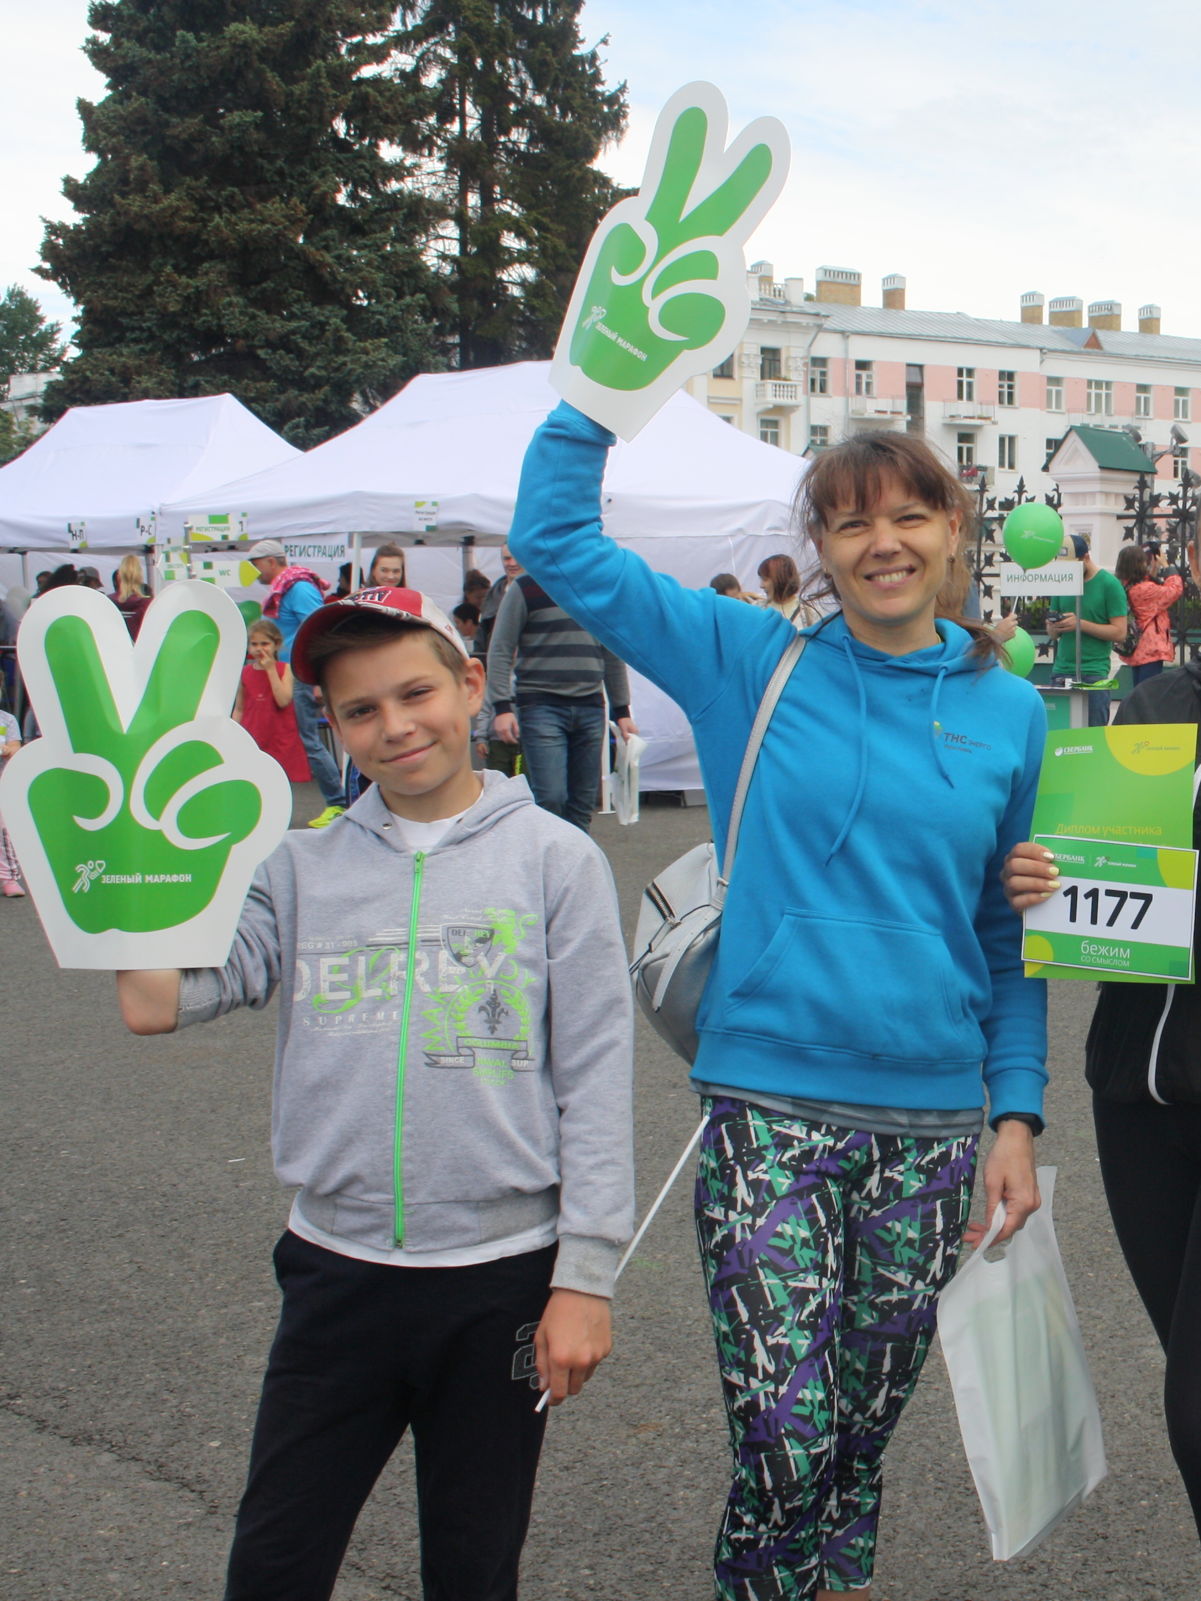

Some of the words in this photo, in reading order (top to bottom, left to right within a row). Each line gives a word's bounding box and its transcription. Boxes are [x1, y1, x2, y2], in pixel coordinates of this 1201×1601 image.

[284, 544, 346, 560] РЕГИСТРАЦИЯ
[1006, 573, 1074, 583] ИНФОРМАЦИЯ
[101, 873, 142, 884] ЗЕЛЕНЫЙ
[145, 874, 192, 883] МАРАФОН
[1063, 885, 1154, 930] 1177
[1081, 940, 1131, 959] бежим
